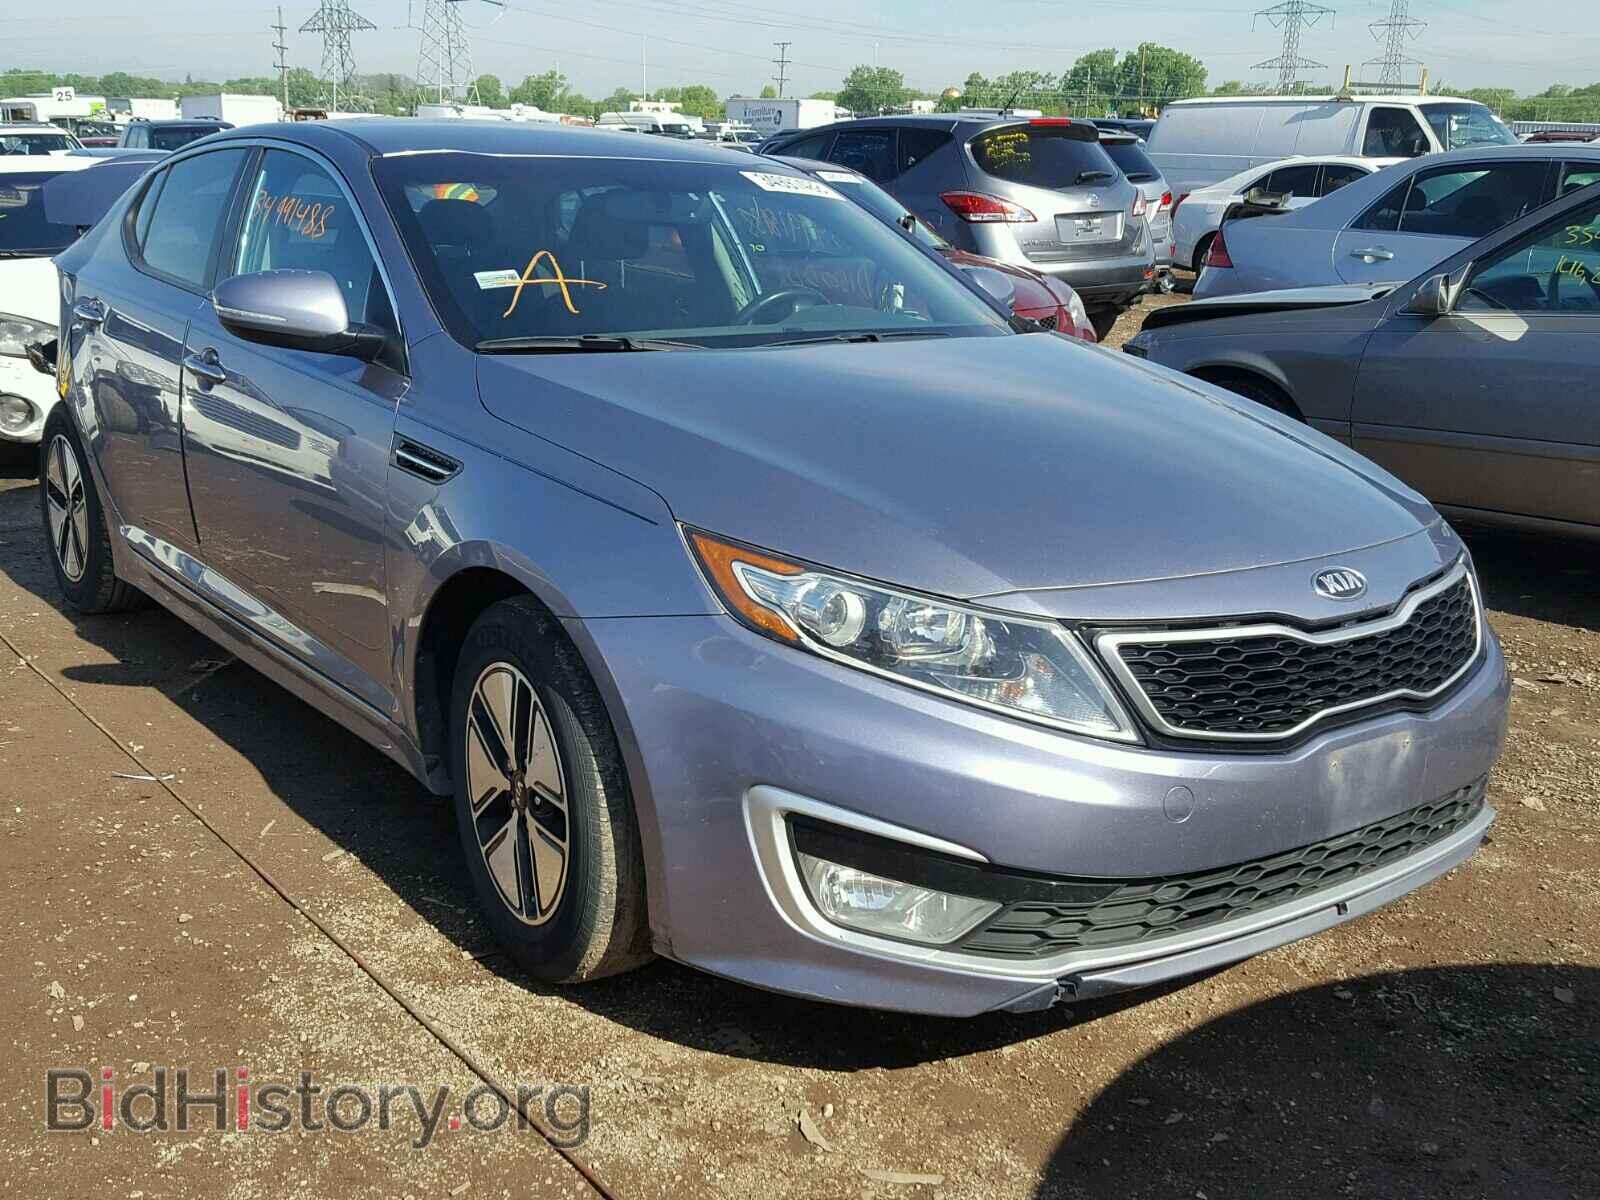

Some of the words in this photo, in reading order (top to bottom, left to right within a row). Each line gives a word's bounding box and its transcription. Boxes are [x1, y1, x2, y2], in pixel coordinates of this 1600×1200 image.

[57, 90, 73, 102] 25
[503, 250, 608, 319] A
[1319, 571, 1363, 594] KIA
